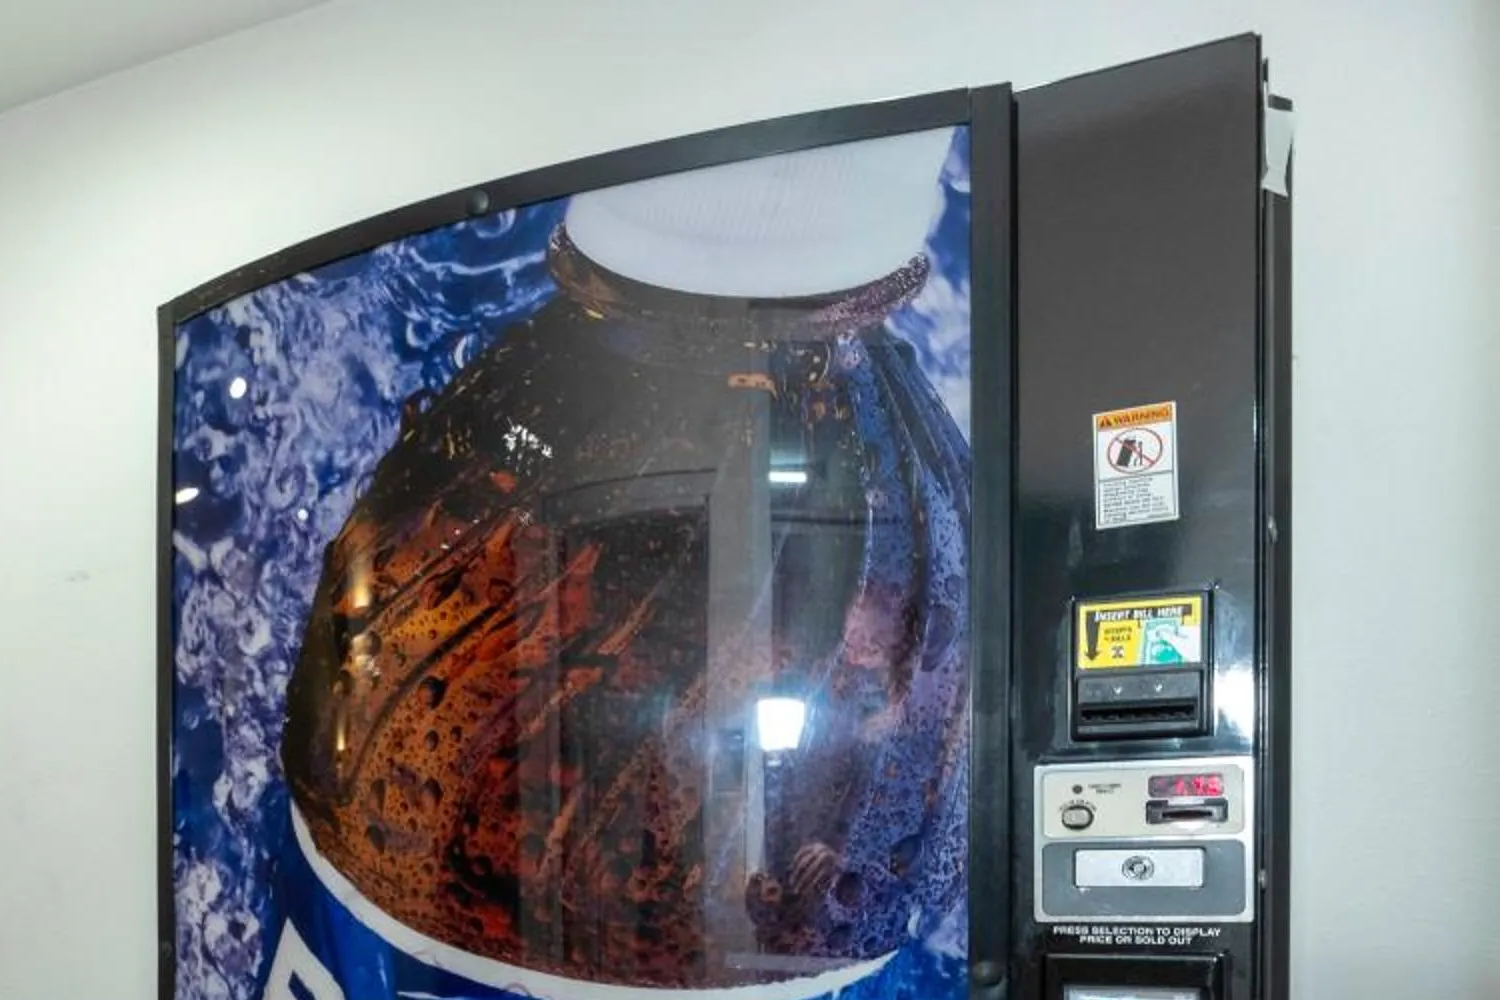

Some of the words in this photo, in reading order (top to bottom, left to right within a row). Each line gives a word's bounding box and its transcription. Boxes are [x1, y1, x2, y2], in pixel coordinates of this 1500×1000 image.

[1113, 407, 1169, 425] WARNING
[1094, 609, 1130, 622] INSERT
[1132, 608, 1153, 620] BILL
[1157, 606, 1183, 618] HERE
[1053, 925, 1089, 935] PRESS
[1091, 926, 1152, 936] SELECTION
[1156, 927, 1171, 936] TO
[1173, 927, 1221, 937] DISPLAY
[1079, 935, 1112, 945] PRICE
[1115, 935, 1132, 945] OR
[1135, 936, 1166, 945] SOLD
[1168, 936, 1193, 945] OUT
